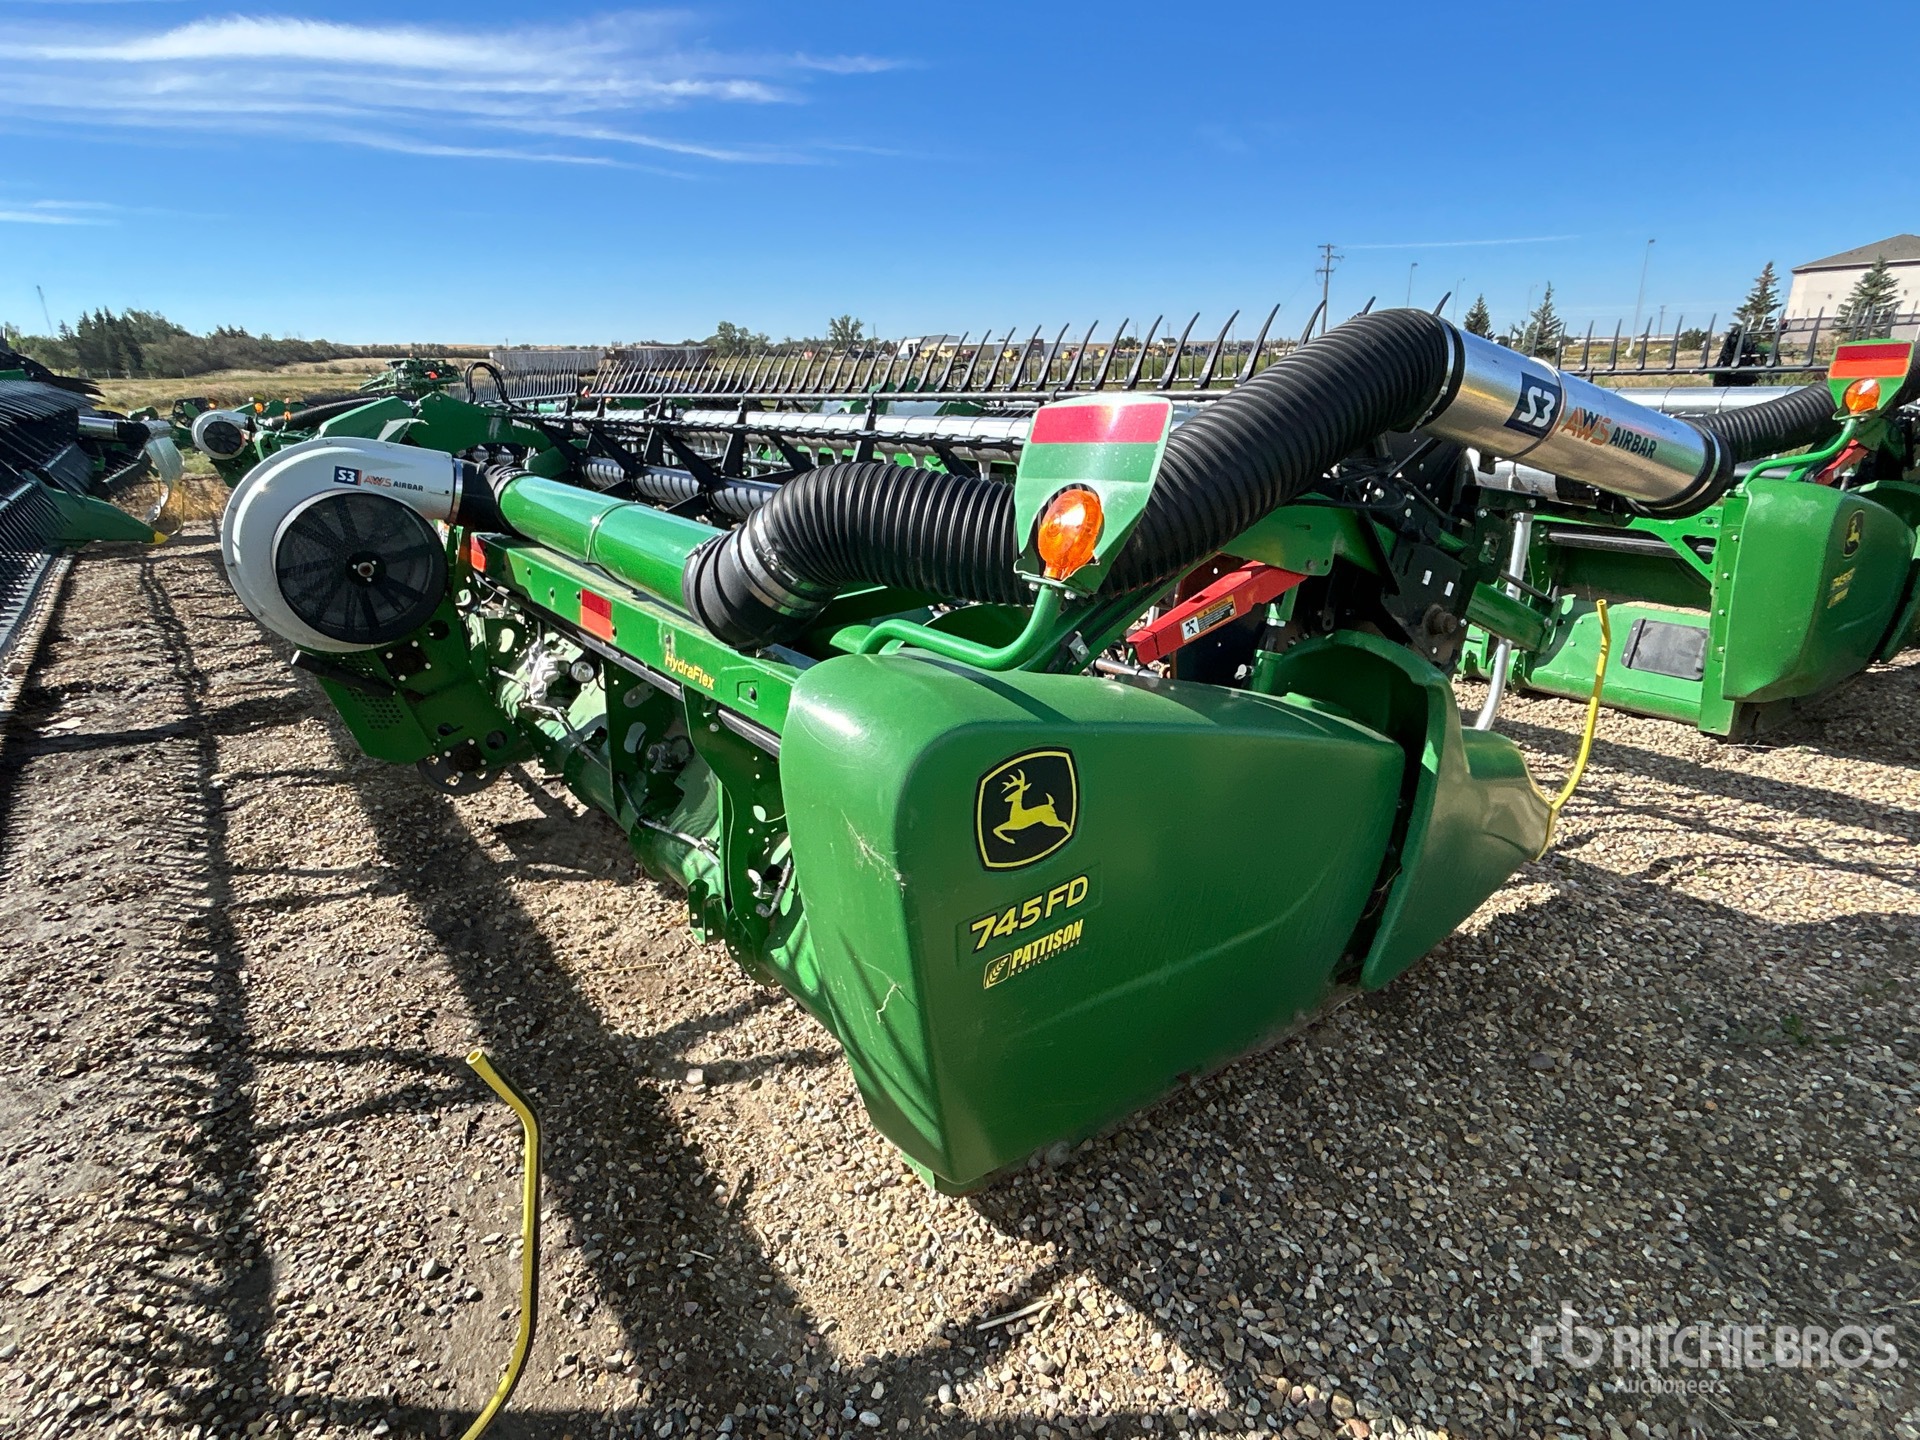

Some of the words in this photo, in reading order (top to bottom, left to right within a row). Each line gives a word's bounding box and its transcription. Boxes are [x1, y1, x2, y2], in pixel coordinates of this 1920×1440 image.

[1518, 386, 1556, 428] S3
[1561, 407, 1612, 446] AWS
[1609, 427, 1658, 459] AIRBAR
[338, 469, 356, 482] S3
[363, 474, 392, 488] AWS
[392, 480, 424, 492] AIRBAR
[664, 650, 715, 691] HydraFlex
[1011, 918, 1084, 970] PATTISON
